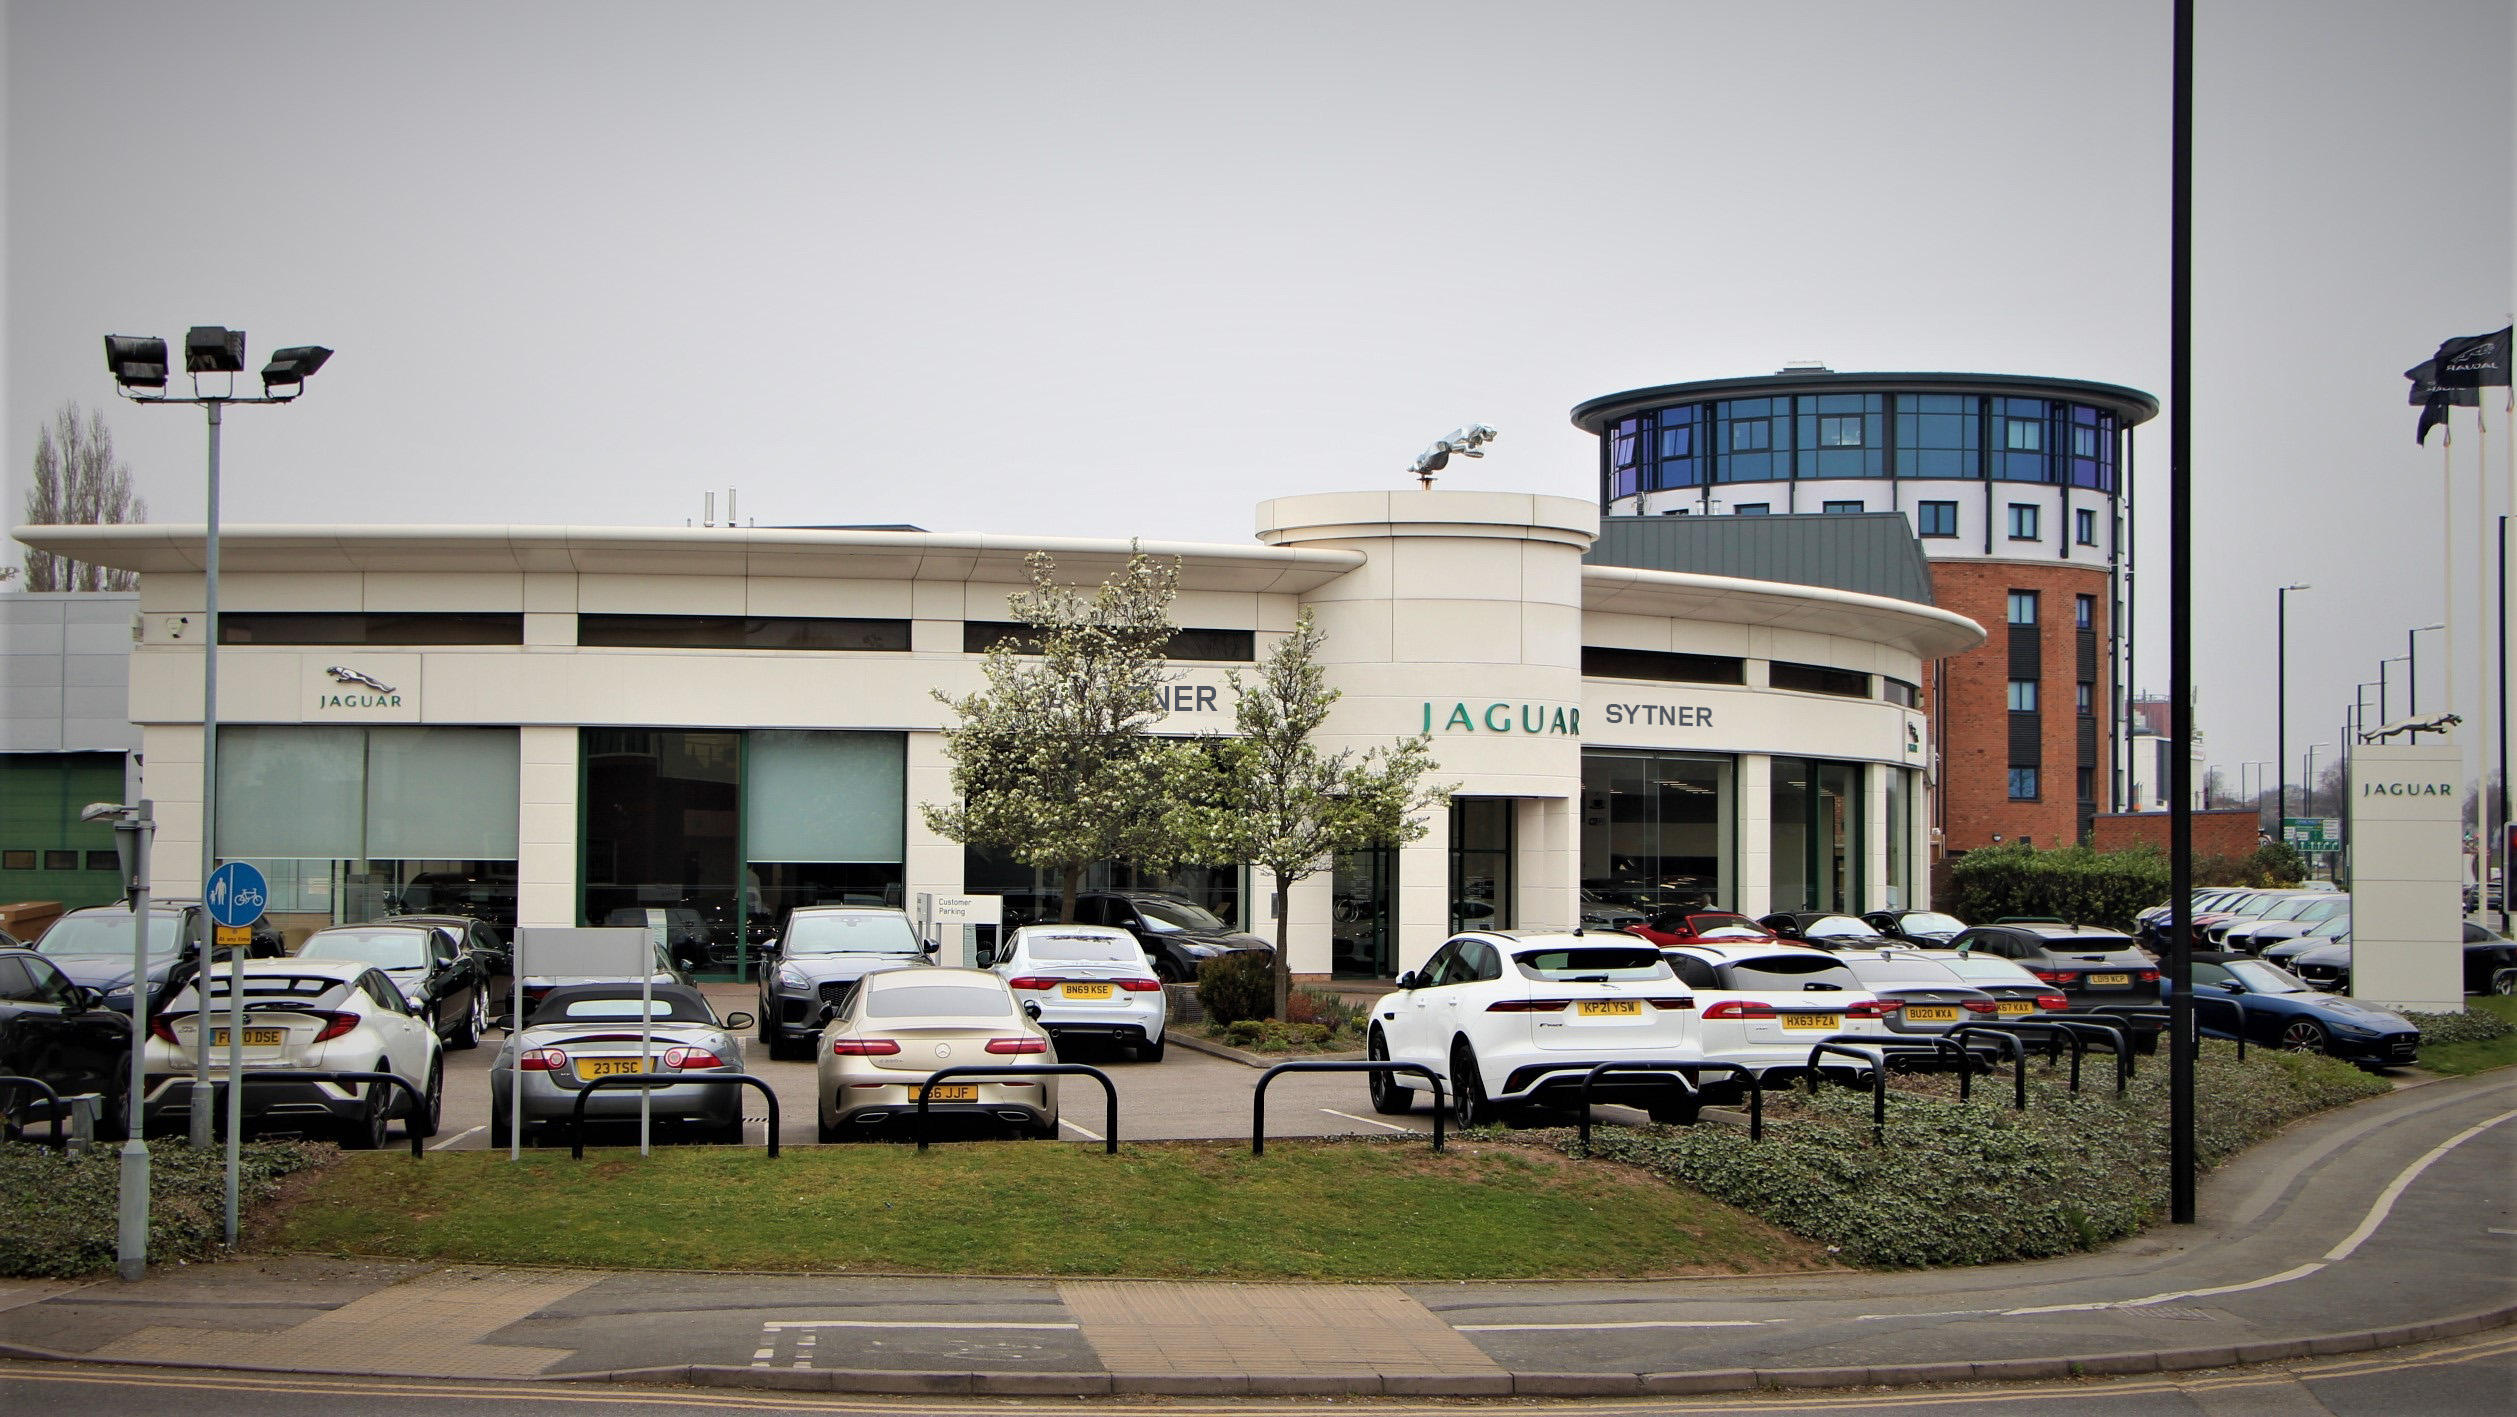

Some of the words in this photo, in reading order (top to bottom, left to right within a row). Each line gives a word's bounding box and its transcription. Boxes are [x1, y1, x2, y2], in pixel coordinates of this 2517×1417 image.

[320, 695, 402, 709] JAGUAR
[1422, 702, 1580, 736] JAGUAR
[1606, 703, 1713, 728] SYTNER
[2364, 783, 2451, 797] JAGUAR
[938, 898, 972, 906] Customer
[939, 907, 966, 917] Parking
[1066, 985, 1089, 994] BN69
[1091, 985, 1109, 994] KSE
[1584, 1003, 1610, 1013] KP21
[1613, 1002, 1635, 1012] YSW
[1910, 1009, 1933, 1018] BU20
[1787, 1016, 1814, 1026] HX63
[1816, 1016, 1835, 1026] FZA
[219, 1032, 252, 1043] F0
[255, 1032, 279, 1043] DSE
[594, 1063, 610, 1074] 23
[614, 1062, 638, 1073] TSC
[946, 1087, 969, 1098] JJF
